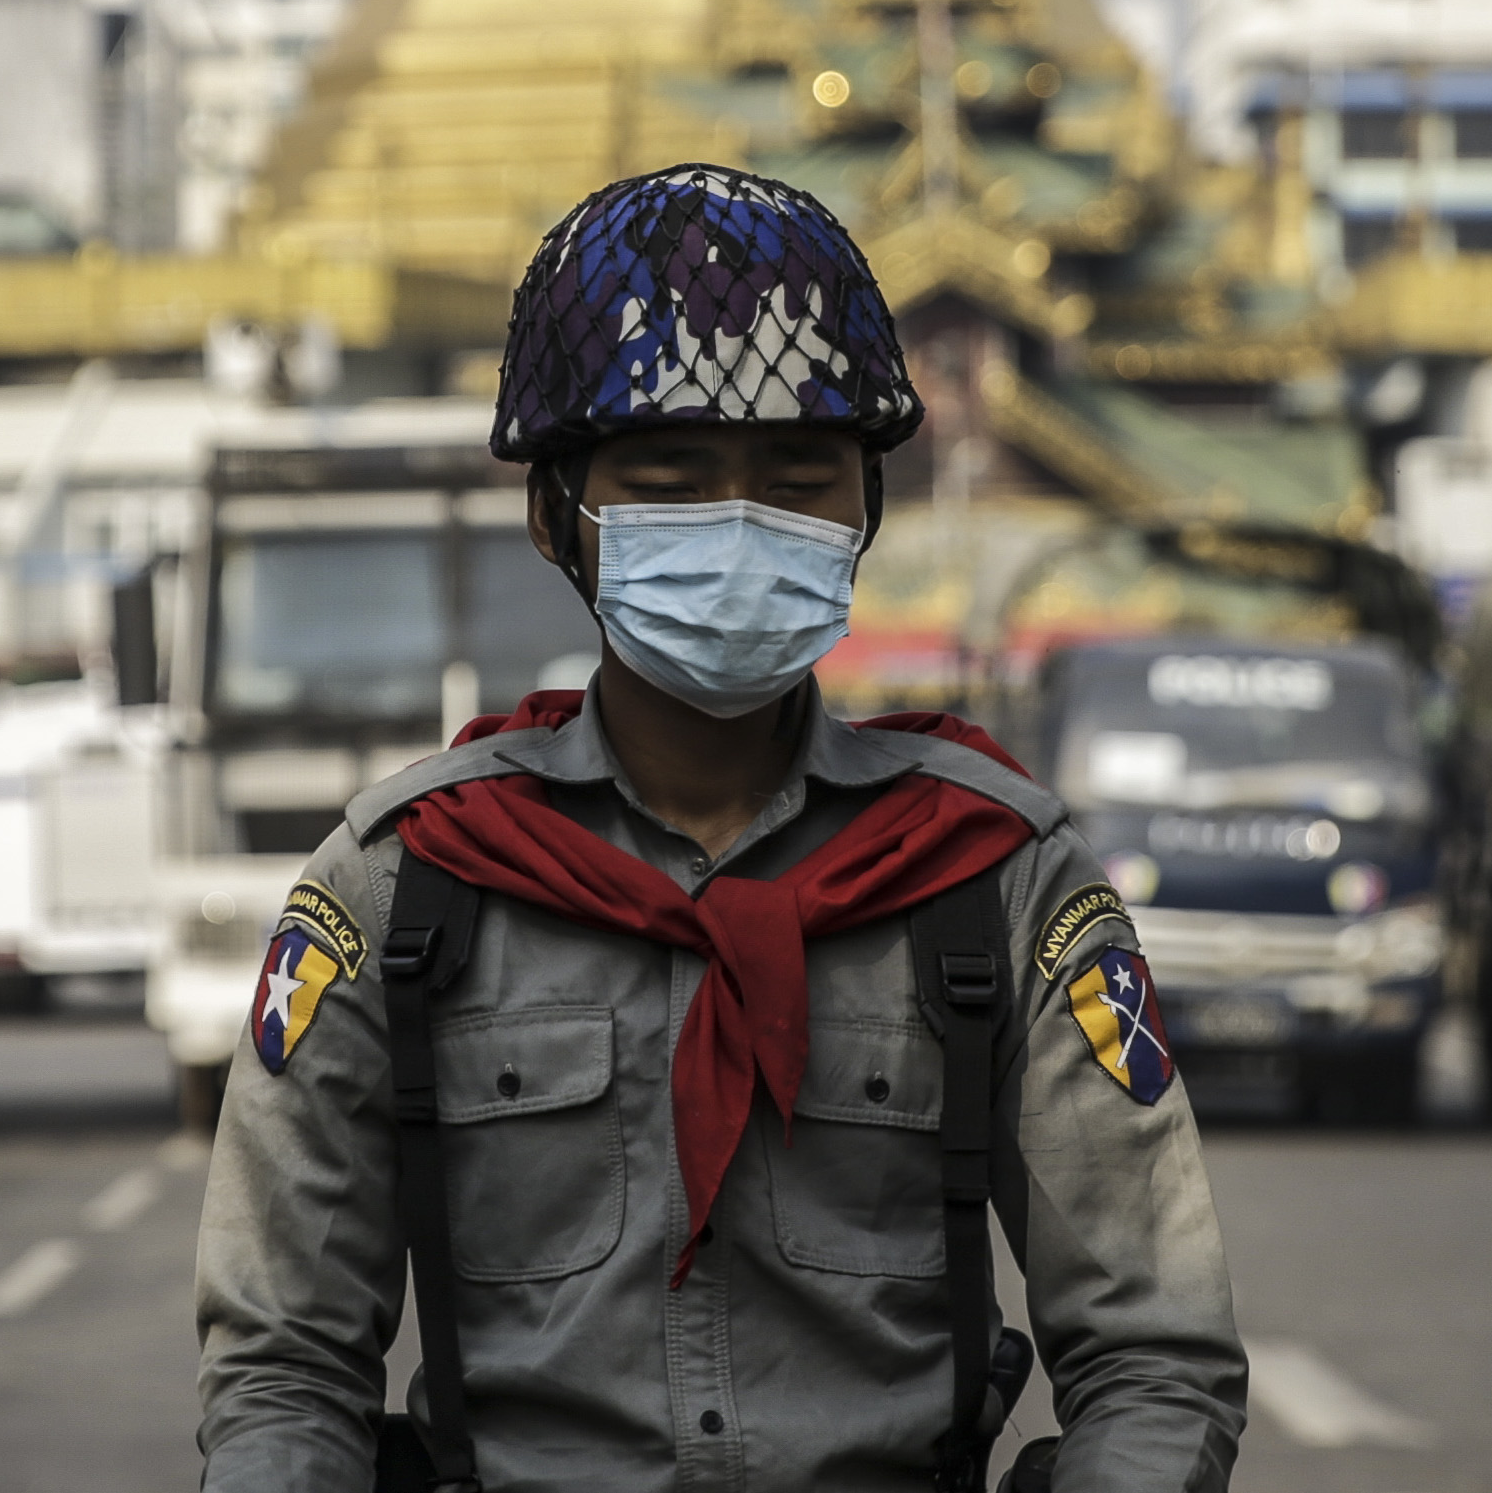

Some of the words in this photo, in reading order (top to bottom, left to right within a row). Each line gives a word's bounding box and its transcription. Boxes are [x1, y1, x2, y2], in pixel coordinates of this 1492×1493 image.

[1148, 655, 1333, 709] POLICE
[316, 901, 359, 954] POLICE
[1043, 894, 1103, 959] MYANMAR
